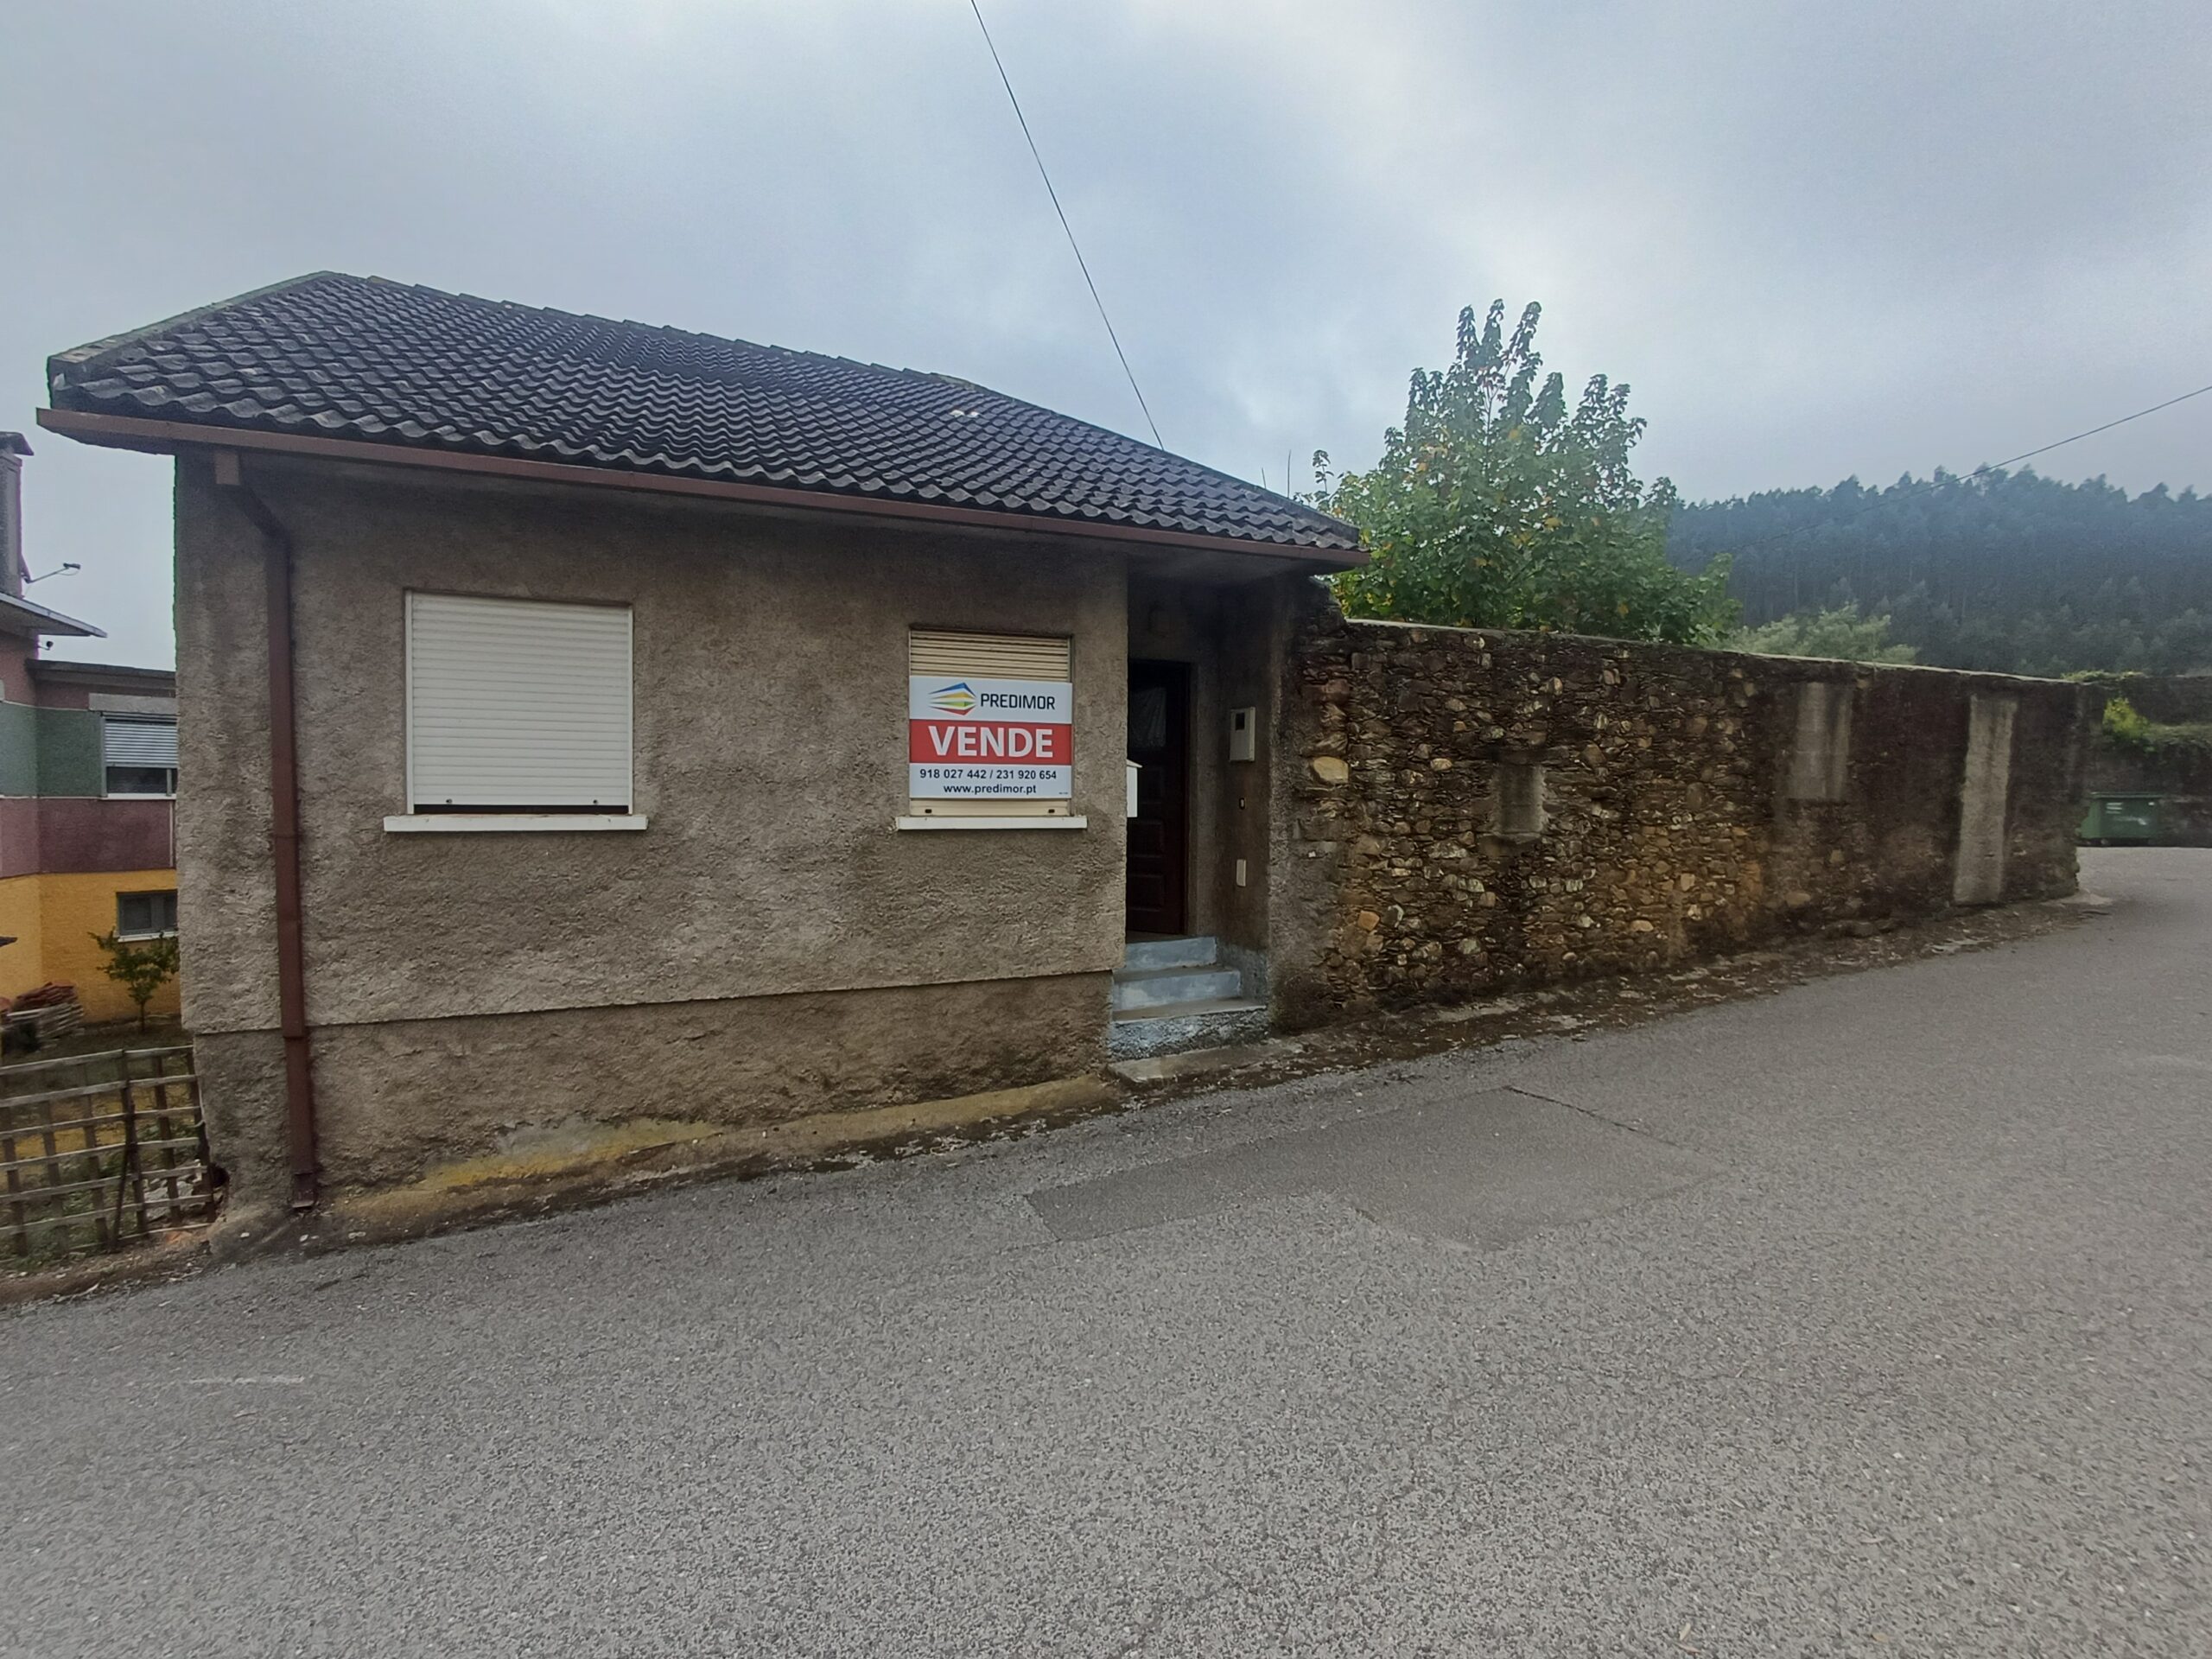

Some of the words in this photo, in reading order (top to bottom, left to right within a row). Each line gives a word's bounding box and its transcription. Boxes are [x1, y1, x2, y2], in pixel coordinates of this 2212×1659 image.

[980, 693, 1055, 710] PREDIMOR
[928, 725, 1053, 758] VENDE
[919, 768, 940, 779] 918
[944, 769, 963, 779] 027
[967, 769, 987, 779] 442
[989, 769, 994, 779] /
[996, 769, 1014, 779] 231
[1018, 770, 1036, 779] 920
[1039, 770, 1057, 779] 654
[944, 784, 1037, 795] www.predimor.pt
